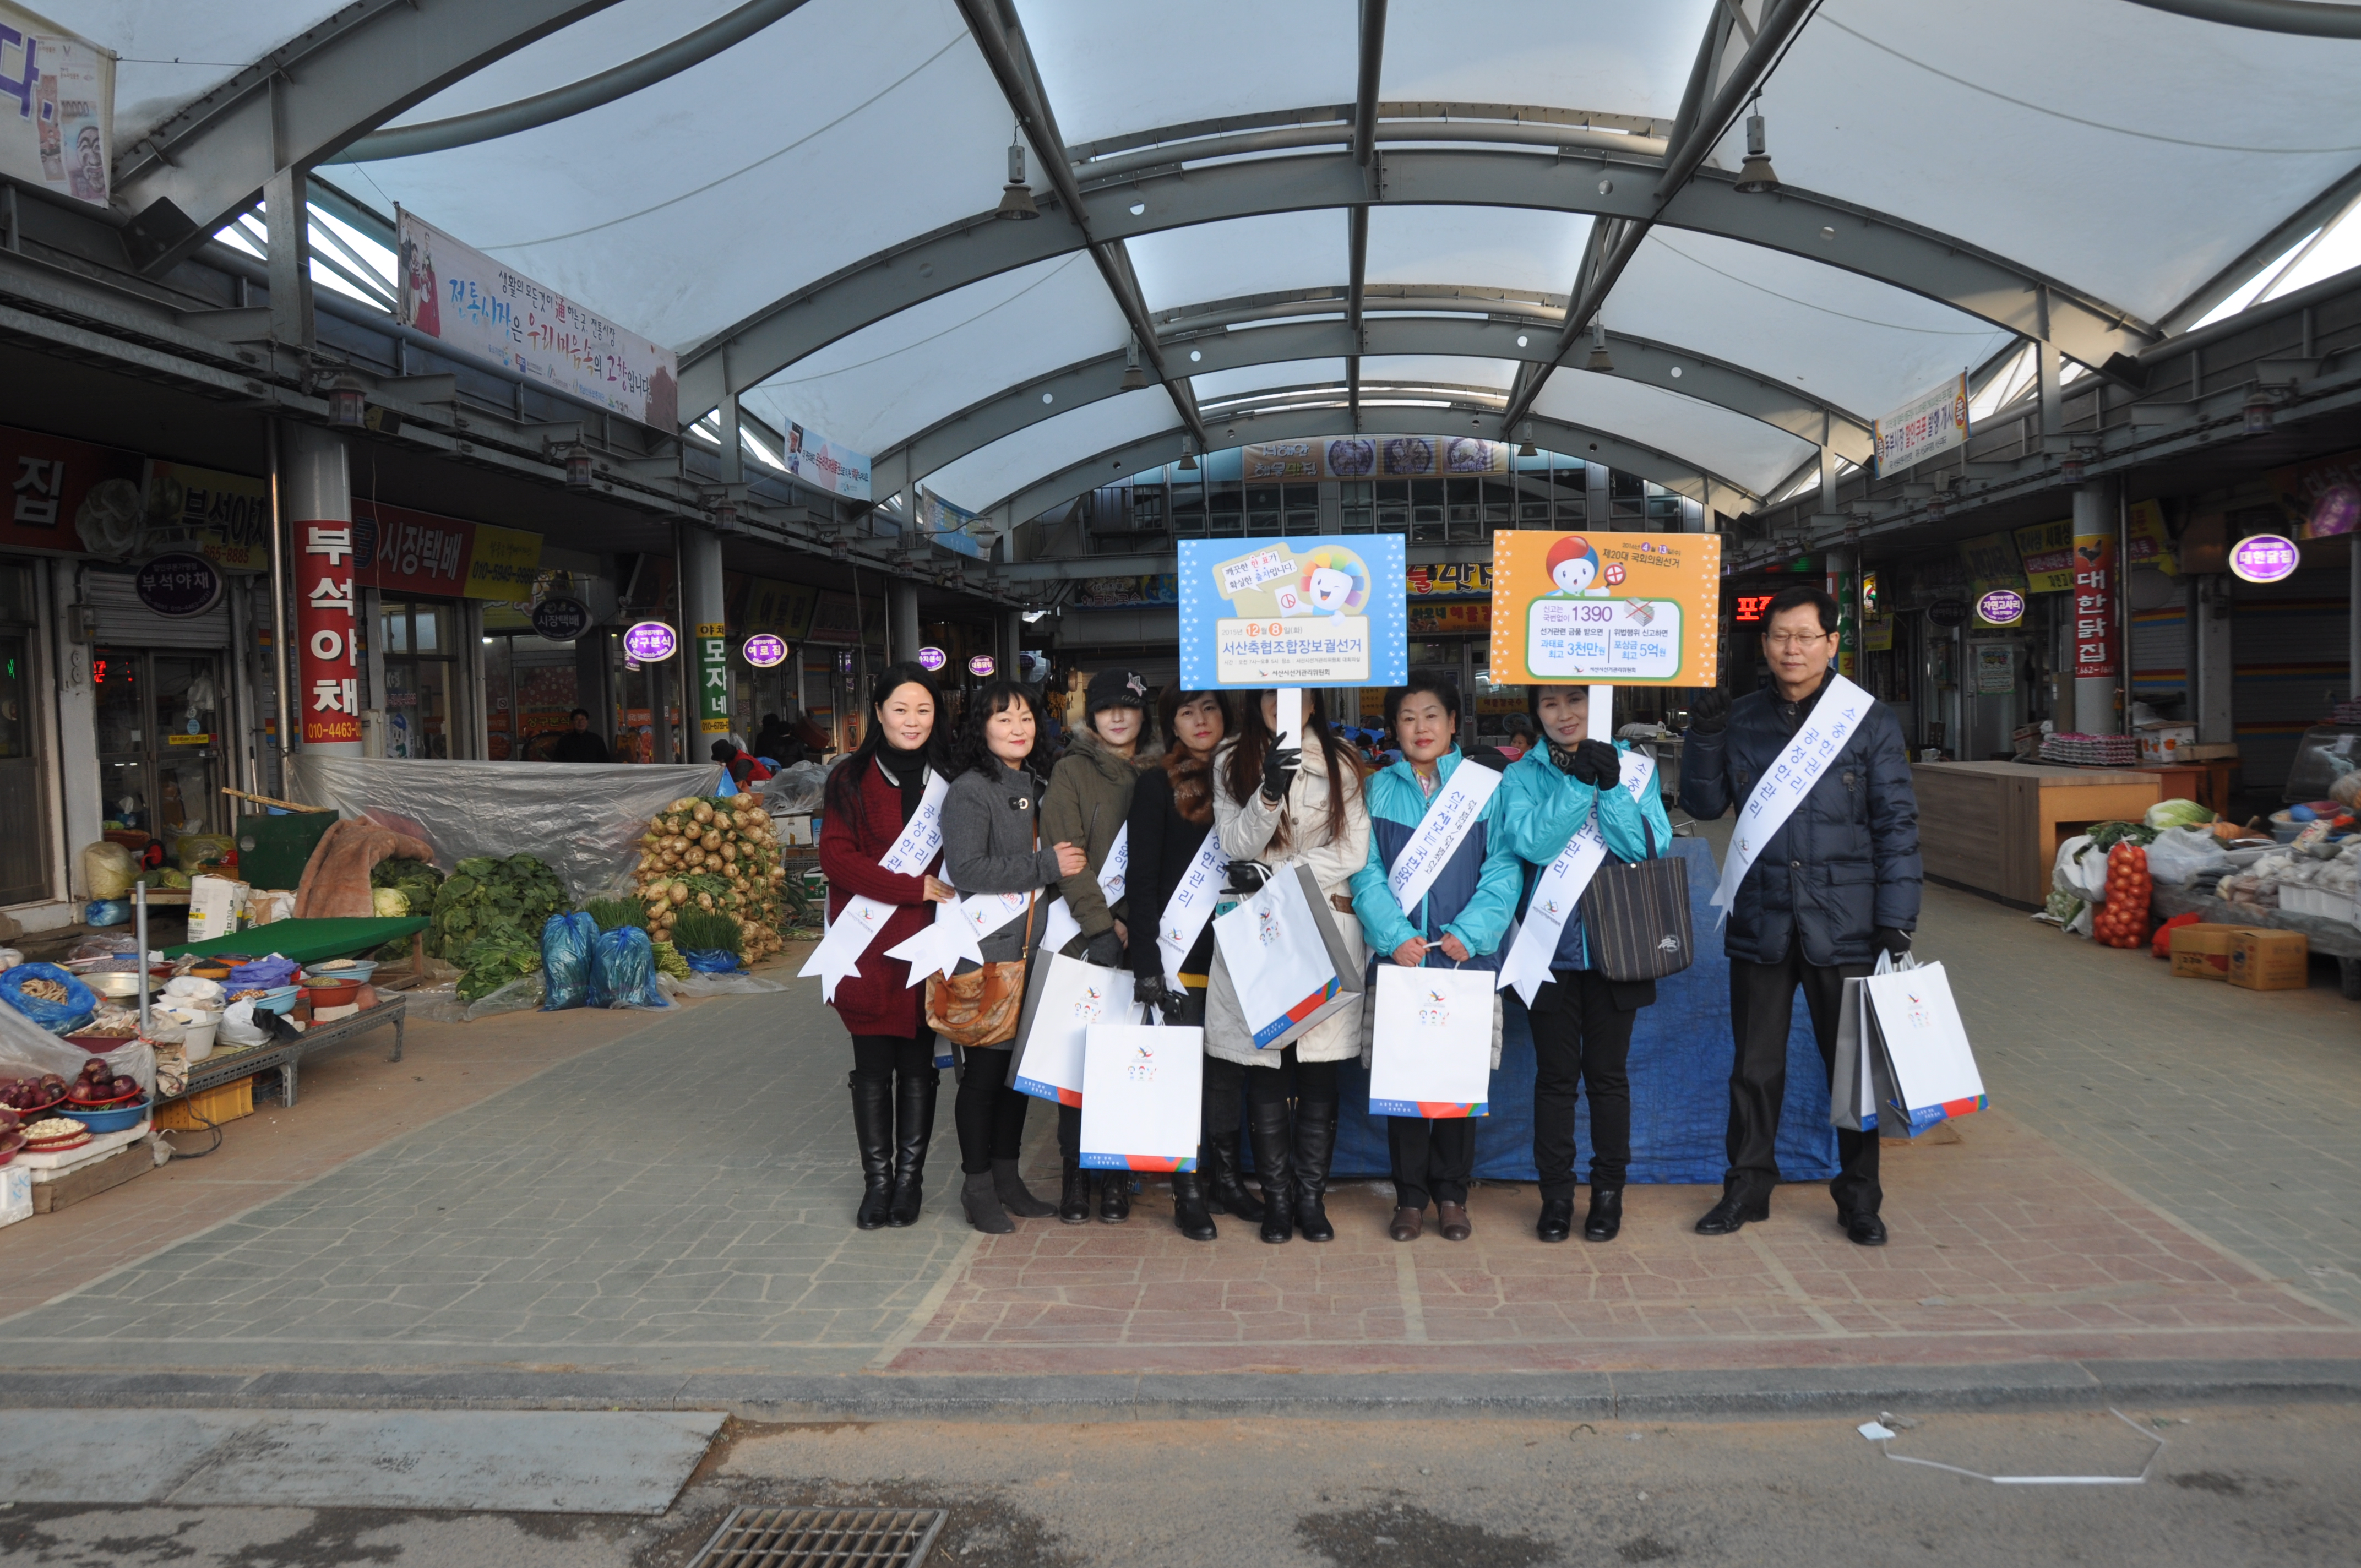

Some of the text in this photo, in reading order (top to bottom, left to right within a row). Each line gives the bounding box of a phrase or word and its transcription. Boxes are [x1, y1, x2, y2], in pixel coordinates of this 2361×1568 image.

[498, 270, 524, 298] 생활의
[591, 317, 615, 347] 전통시장
[527, 312, 553, 352] 우리
[1263, 443, 1310, 457] 서해안
[1254, 461, 1318, 477] 해물맛집
[12, 456, 65, 524] 집
[204, 545, 249, 564] 665-8885
[379, 522, 463, 580] 시장택배
[1622, 542, 1640, 551] 2016년
[1225, 552, 1277, 576] 깨끗한 한 표가
[1602, 548, 1680, 569] 제20대 국회의원선거
[2239, 549, 2293, 565] 대한닭집
[142, 571, 210, 592] 부석야채
[1229, 575, 1253, 589] 확실한
[1081, 592, 1141, 607] 해물칼국수
[1983, 600, 2021, 611] 자연고사리
[1543, 605, 1564, 614] 신고는
[1572, 605, 1613, 623] 1390
[2077, 569, 2108, 663] 대한닭집
[306, 527, 358, 716] 부석야채
[537, 614, 579, 627] 시장택배
[1543, 614, 1570, 623] 국번없이
[1539, 627, 1604, 637] 선거관련 금품 받으면
[1613, 629, 1669, 638] 위법행위 신고하면
[629, 635, 671, 649] 상구분식
[1222, 638, 1362, 656] 서산축협조합장보궐선거
[1540, 639, 1565, 649] 과태료
[1566, 641, 1606, 657] 3천만원
[1613, 640, 1638, 650] 포상금
[747, 645, 781, 656] 여로집
[1548, 650, 1565, 659] 최고
[1621, 651, 1638, 660] 최고
[1639, 643, 1667, 658] 5억원
[704, 640, 727, 714] 모자네
[1271, 668, 1330, 677] 서산시선거관리위원회
[527, 716, 570, 728] 상구분식
[1790, 707, 1856, 796] 소중한 권리
[1749, 727, 1820, 819] 공정한 관리
[900, 803, 935, 857] 공정한
[915, 830, 941, 866] 권리
[1395, 845, 1428, 891] 국번없이
[1553, 842, 1581, 879] 관리
[1179, 870, 1205, 908] 관리
